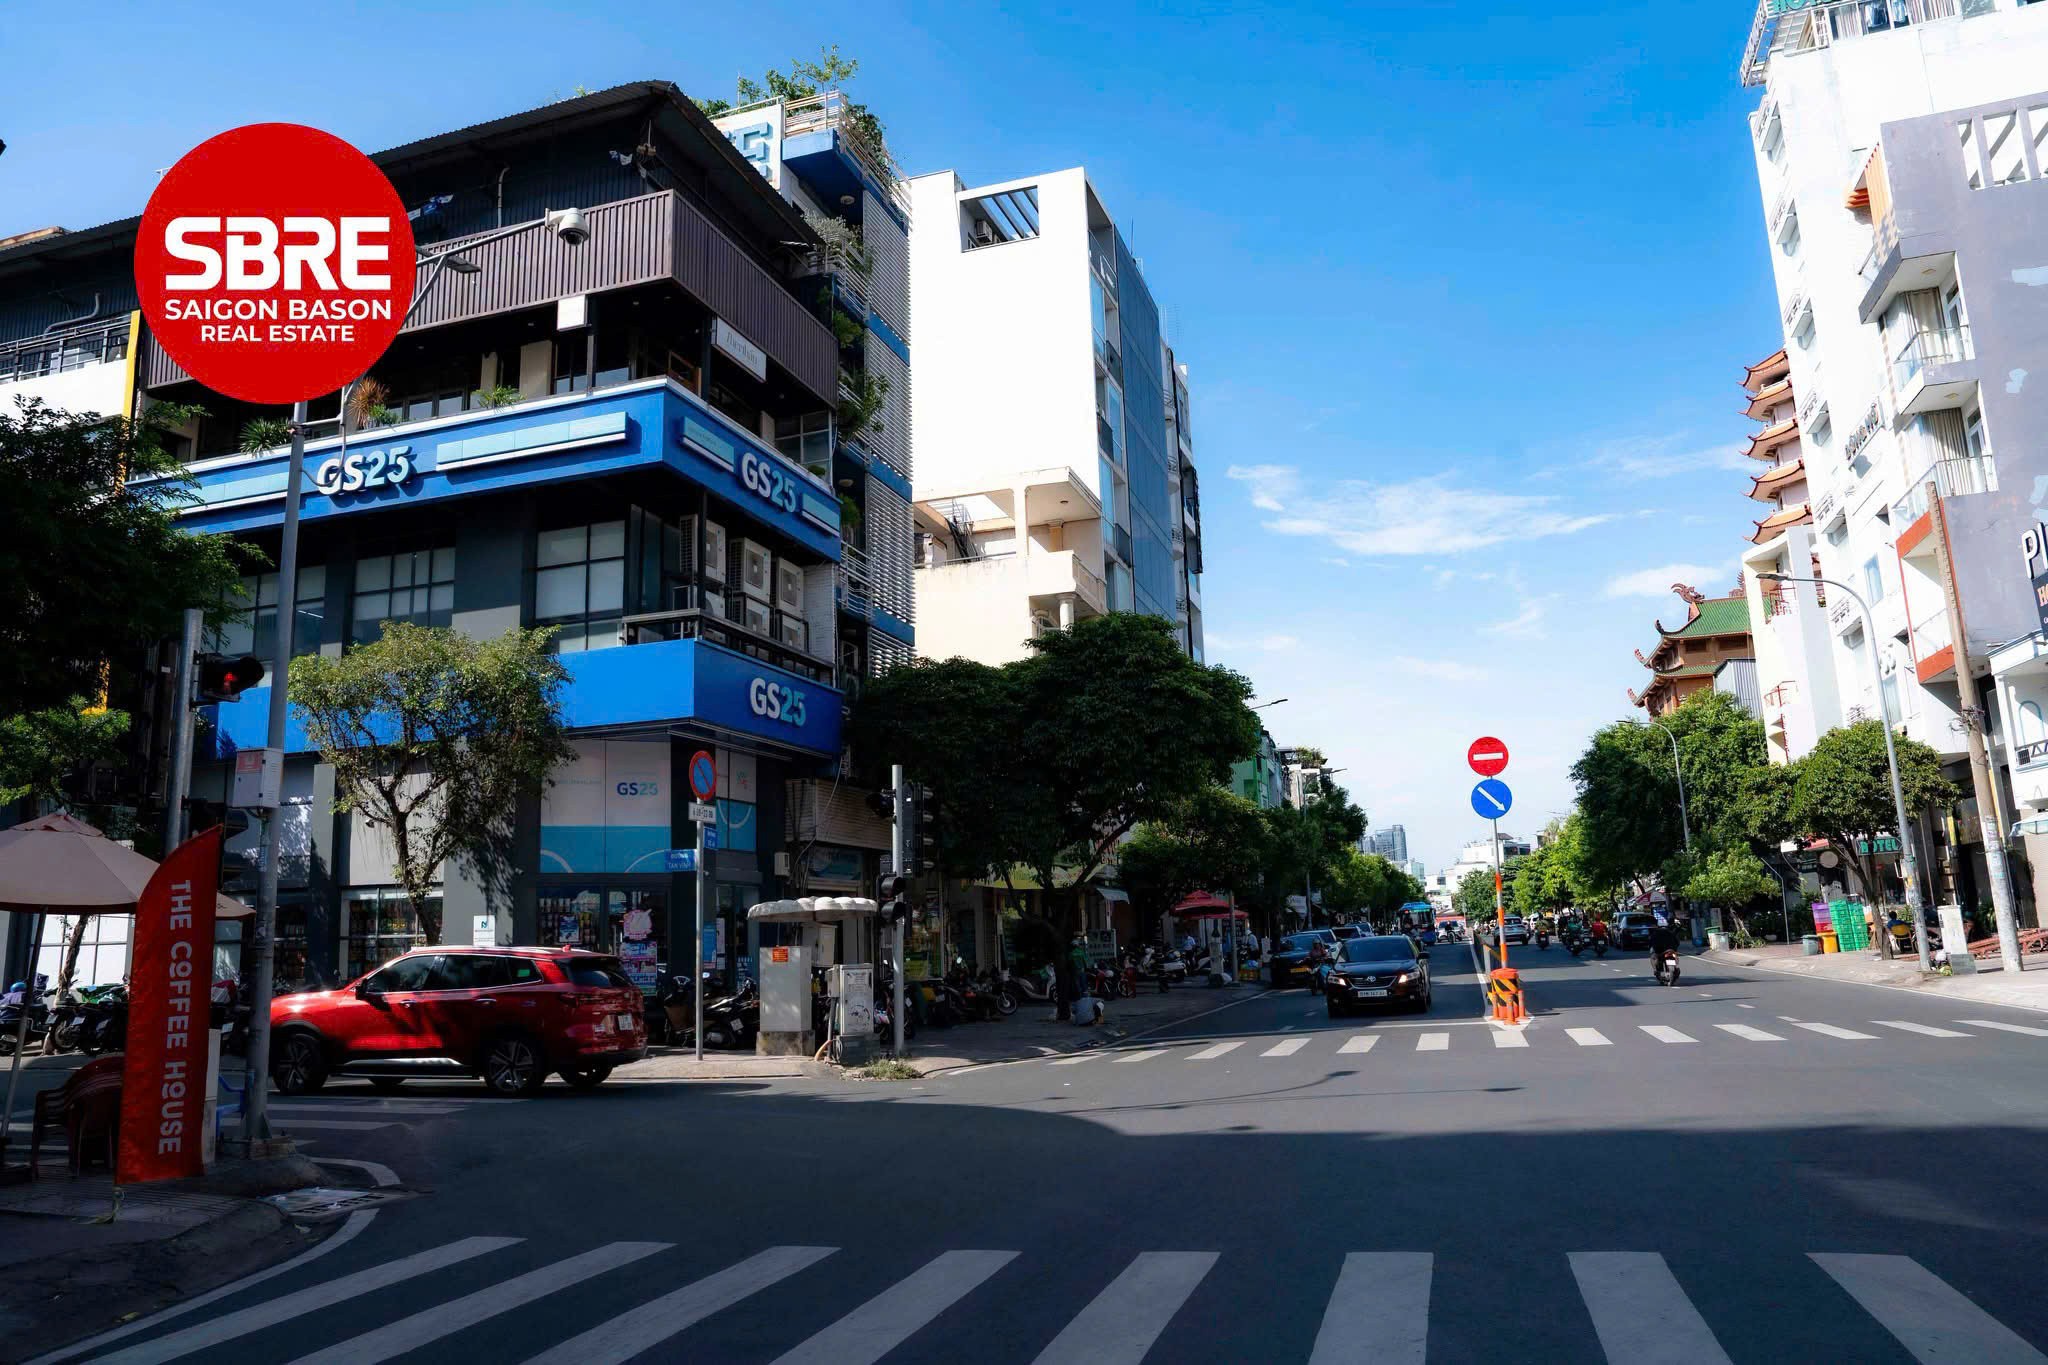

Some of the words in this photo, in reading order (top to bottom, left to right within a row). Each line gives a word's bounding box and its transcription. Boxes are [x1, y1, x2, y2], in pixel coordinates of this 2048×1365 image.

[317, 445, 410, 495] GS25
[742, 452, 796, 513] GS25
[750, 677, 806, 727] GS25
[616, 782, 658, 796] GS25
[169, 879, 193, 931] THE
[168, 940, 193, 1049] COFFEE
[158, 1060, 188, 1154] HOUSE
